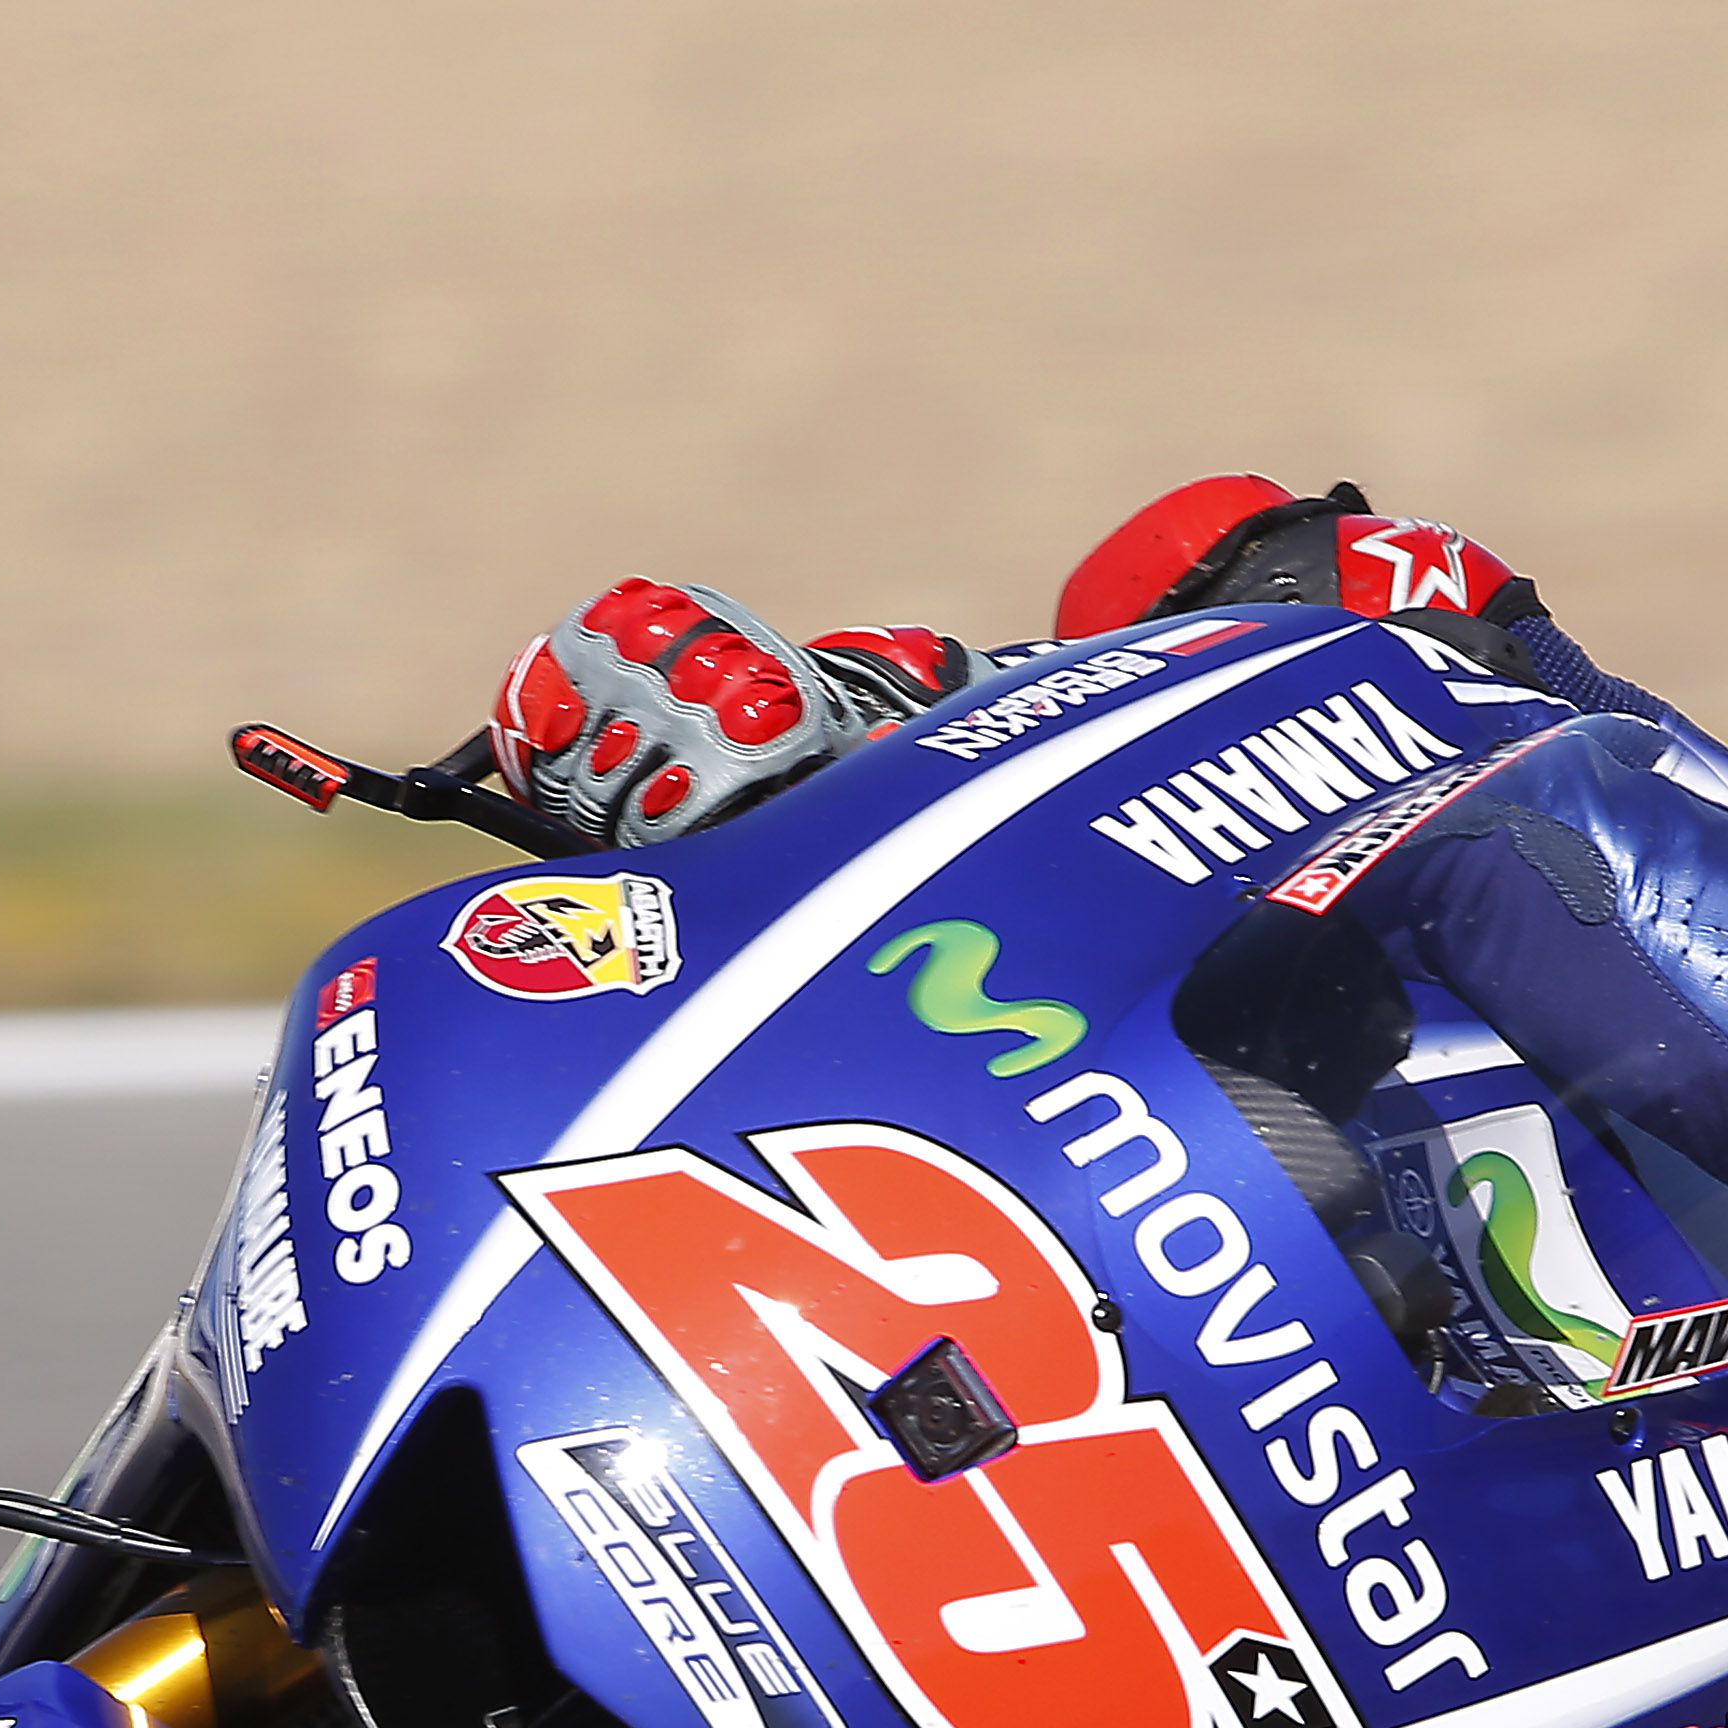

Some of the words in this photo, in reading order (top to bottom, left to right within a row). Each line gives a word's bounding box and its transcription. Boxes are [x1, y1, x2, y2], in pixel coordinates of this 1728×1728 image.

[1090, 682, 1463, 885] YAMAHA
[628, 881, 667, 978] ABARTH
[313, 1008, 412, 1286] ENEOS
[1024, 1069, 1489, 1693] movistar
[563, 1488, 740, 1702] CORE
[622, 1474, 803, 1697] BLUE
